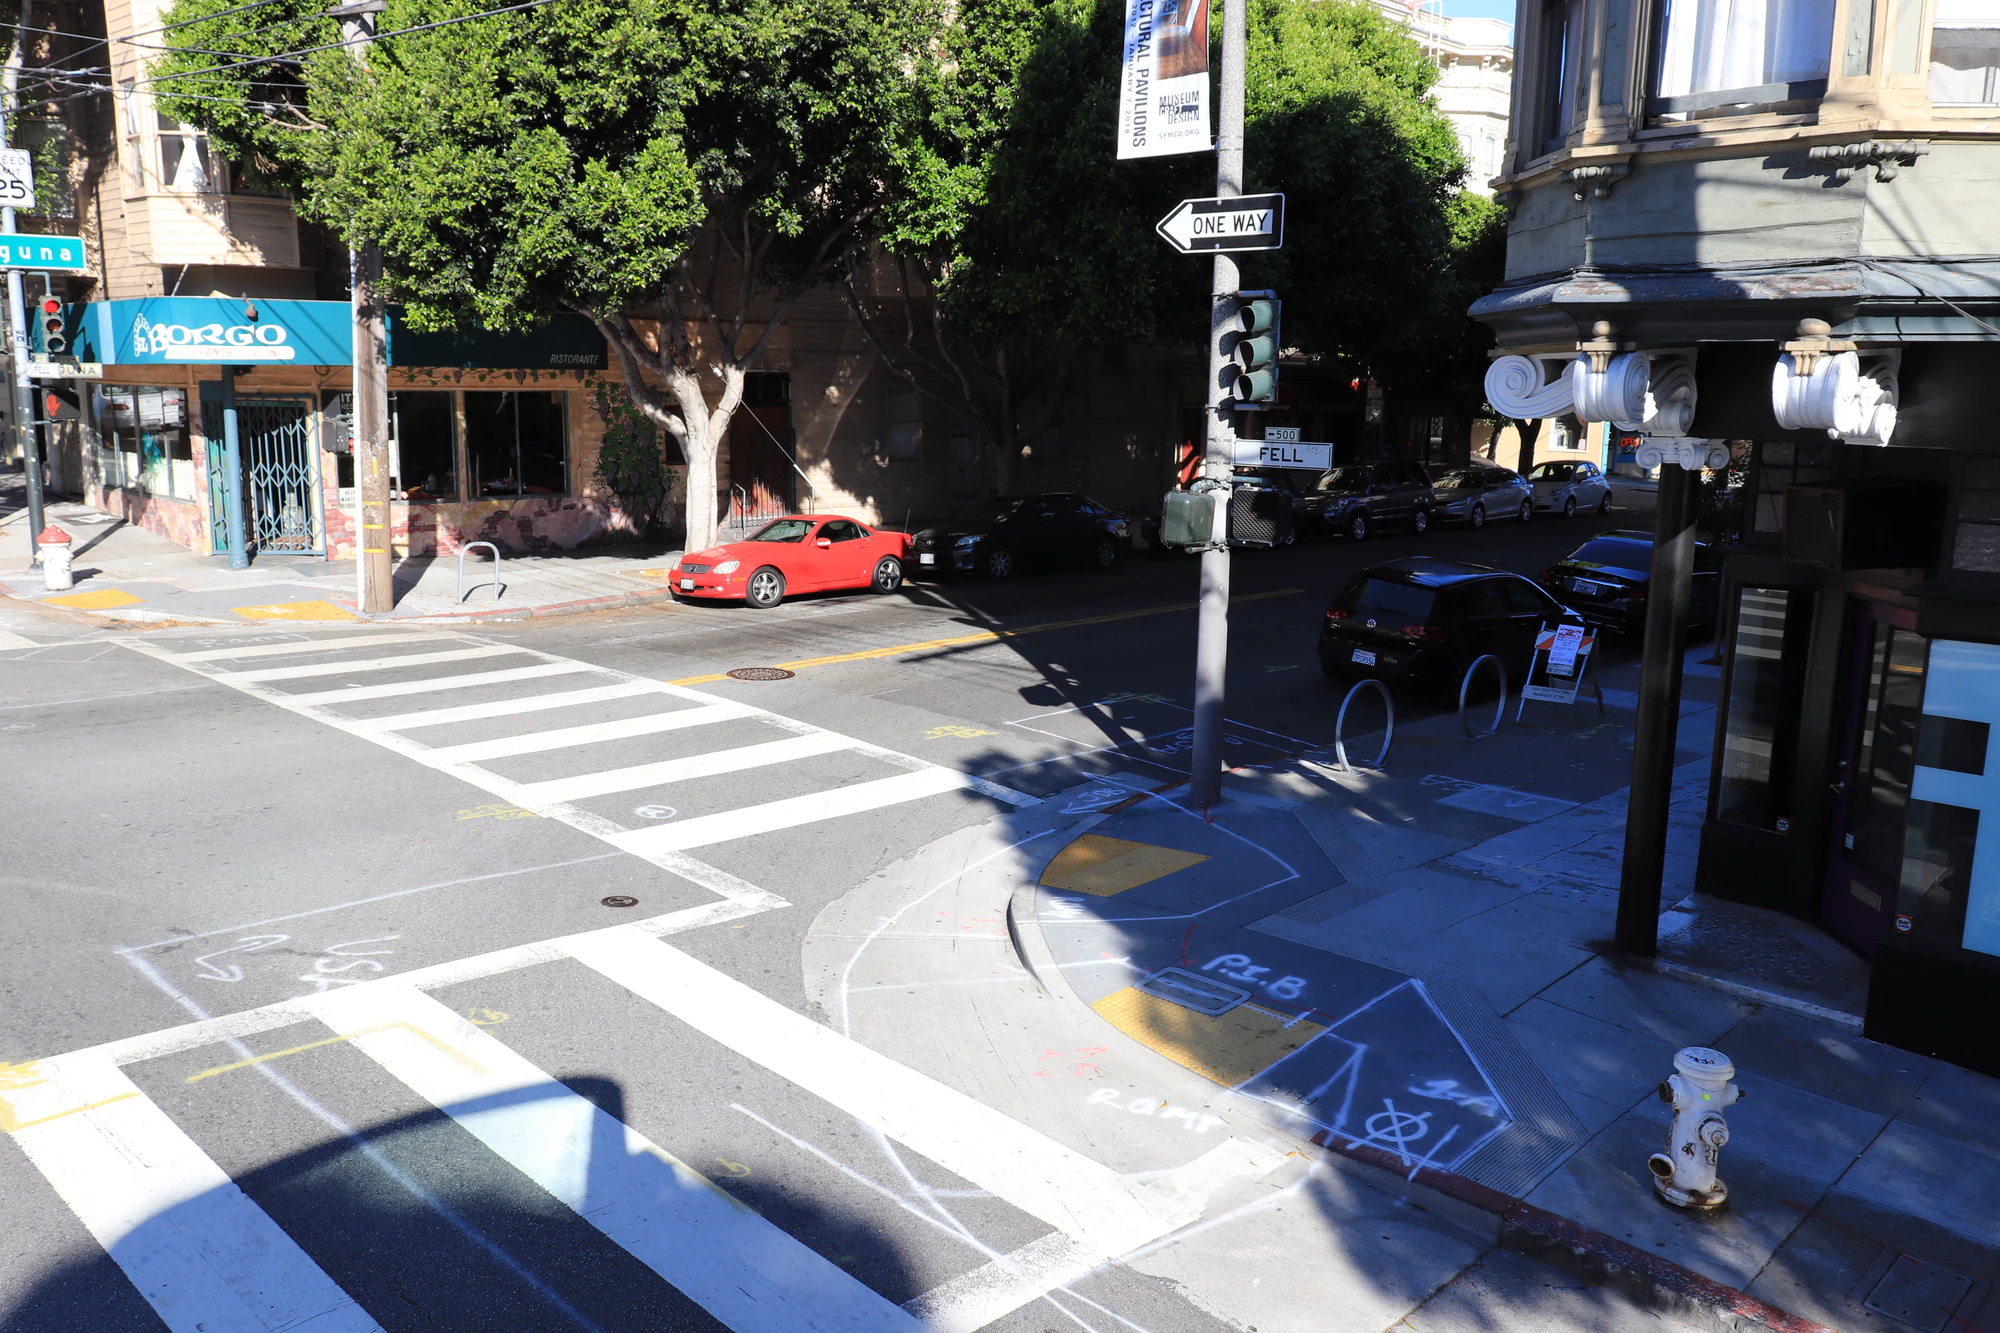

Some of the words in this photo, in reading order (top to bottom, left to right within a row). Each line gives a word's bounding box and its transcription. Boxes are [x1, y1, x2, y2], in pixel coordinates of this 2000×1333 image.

[1127, 43, 1135, 92] JANUARY
[1160, 91, 1199, 105] MUSEUM
[1133, 68, 1149, 147] PAVILIONS
[1168, 110, 1199, 124] DESIGN
[1193, 215, 1226, 235] ONE
[1233, 213, 1269, 232] WAY
[0, 245, 72, 263] guna
[150, 323, 287, 355] BORGO
[550, 353, 600, 365] RISTORANTE
[1276, 430, 1296, 440] 500
[1259, 447, 1304, 463] FELL
